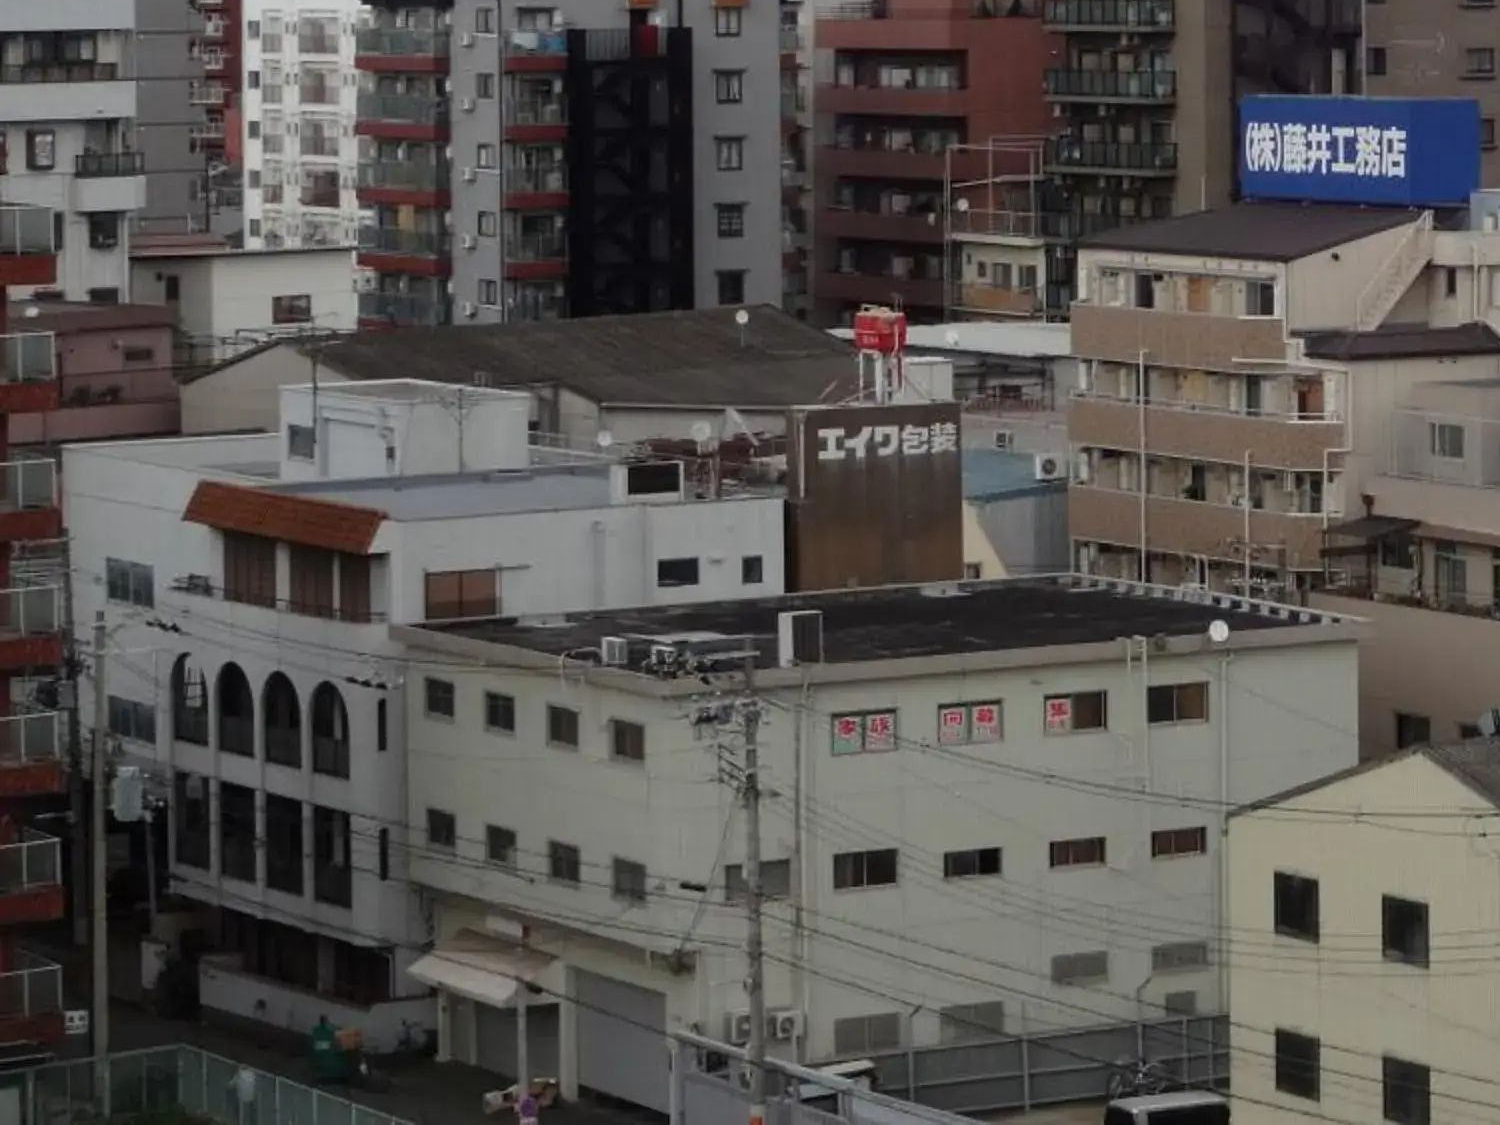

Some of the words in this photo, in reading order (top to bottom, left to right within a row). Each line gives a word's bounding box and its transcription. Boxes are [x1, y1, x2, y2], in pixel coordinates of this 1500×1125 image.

[1245, 122, 1407, 178] (株)藤井工務店
[817, 423, 957, 460] エイワ包装
